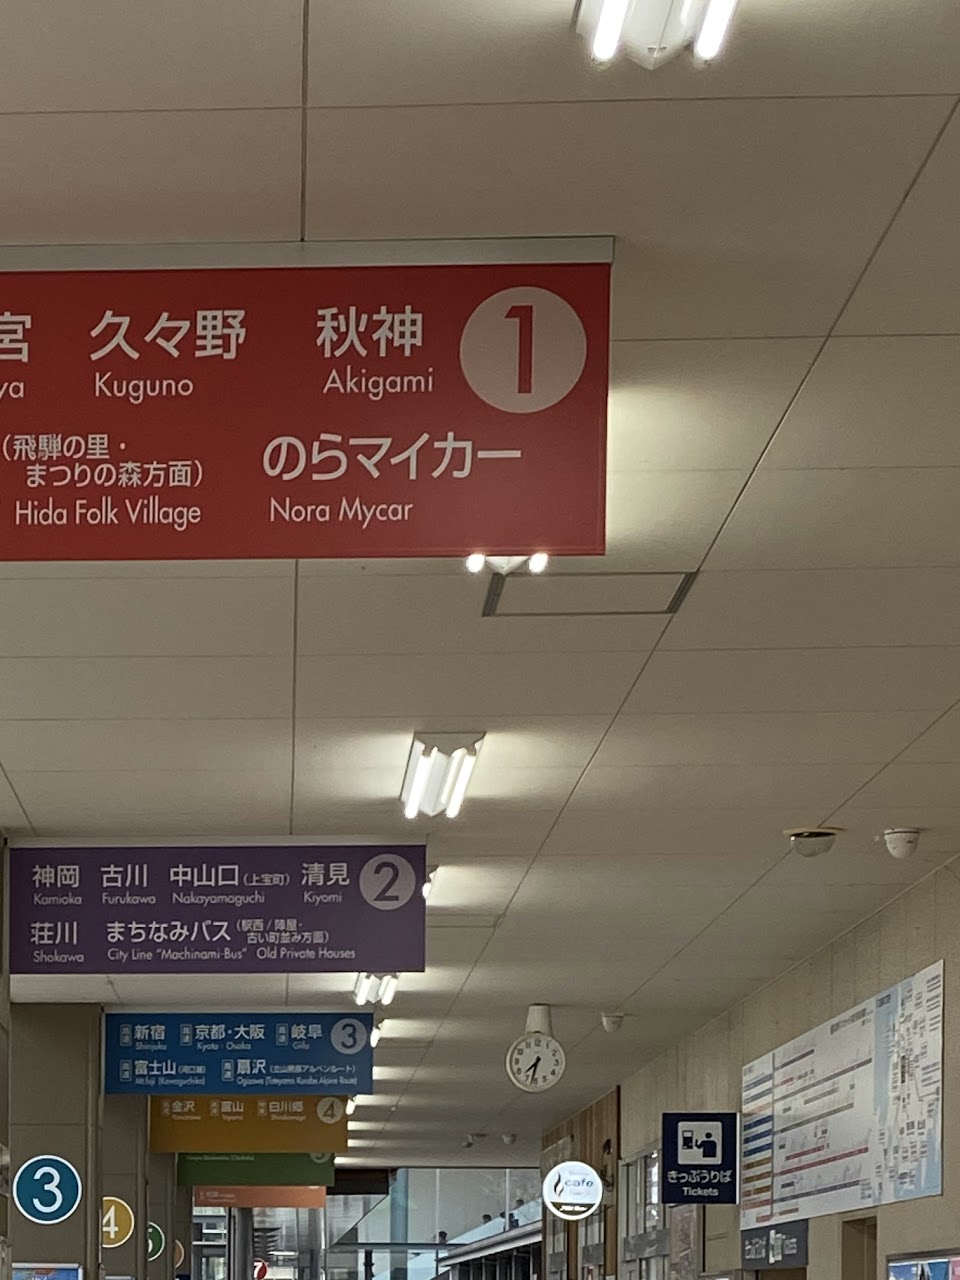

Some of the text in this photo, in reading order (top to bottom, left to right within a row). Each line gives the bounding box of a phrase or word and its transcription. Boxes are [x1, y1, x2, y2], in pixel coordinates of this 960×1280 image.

[90, 309, 246, 361] 久々野
[316, 305, 423, 357] 秋神
[504, 305, 534, 394] 1
[95, 372, 193, 404] Kuguno
[323, 365, 434, 400] Akigami
[262, 431, 522, 480] のらマイカー
[26, 460, 203, 487] まつりの森方面）
[15, 497, 67, 525] Hida
[75, 496, 118, 524] Folk
[125, 496, 201, 531] Village
[269, 496, 330, 522] Nora
[339, 496, 413, 529] Mycar
[33, 865, 79, 888] 神岡
[100, 864, 148, 887] 古川
[170, 864, 239, 887] 中山口
[301, 863, 350, 886] 清見
[373, 862, 399, 901] 2
[34, 890, 342, 907] Kamioka Furukawa Nakayamaguchi Kiyomi
[30, 920, 231, 945] 荘川 まちなみバス
[33, 950, 84, 963] Shokawa
[107, 948, 128, 962] City
[132, 948, 152, 960] Line
[257, 947, 277, 959] Old
[281, 947, 315, 959] Private
[318, 947, 356, 959] Houses
[134, 1024, 165, 1040] 新宿
[195, 1024, 265, 1040] 京都・大阪
[291, 1024, 323, 1040] 岐阜
[340, 1023, 358, 1049] 3
[134, 1059, 177, 1075] 富士山
[33, 1166, 63, 1213] 3
[667, 1170, 732, 1183] きっぷうりば
[683, 1187, 719, 1196] Tickets
[102, 1204, 118, 1238] 4
